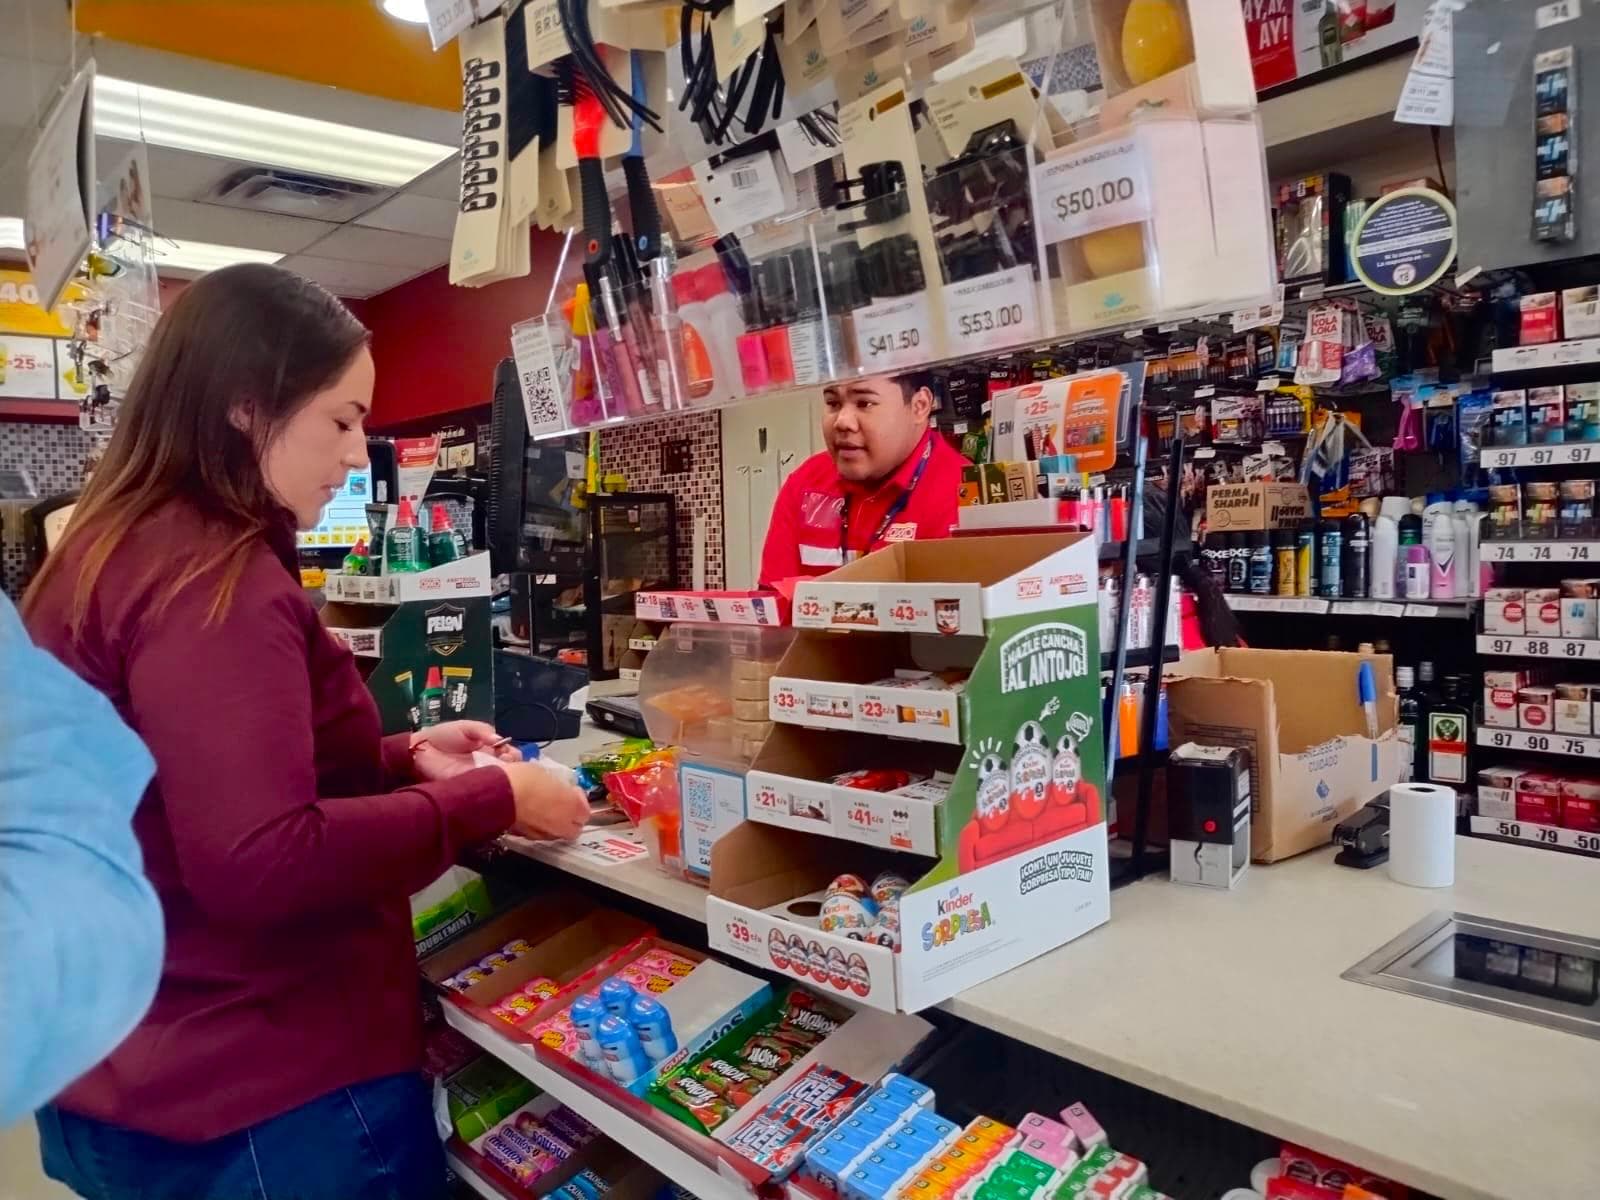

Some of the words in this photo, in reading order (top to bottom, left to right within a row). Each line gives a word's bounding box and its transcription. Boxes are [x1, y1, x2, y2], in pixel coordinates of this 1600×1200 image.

[1259, 15, 1288, 51] AY!
[1056, 177, 1134, 222] $50.00
[959, 303, 1023, 337] $53.00
[1312, 315, 1338, 326] KOLA
[868, 328, 920, 356] $41.50
[1497, 452, 1517, 466] 97
[1533, 450, 1553, 464] 97
[1570, 448, 1591, 462] 97
[1211, 488, 1249, 499] PERMA
[1213, 498, 1249, 509] SHARP
[1497, 547, 1515, 560] 74
[1533, 547, 1551, 560] 74
[1570, 546, 1589, 560] 74
[798, 602, 821, 617] $32
[889, 605, 916, 621] $43
[1007, 636, 1041, 669] HAZLE
[1041, 633, 1081, 655] CANCHA
[1494, 639, 1513, 653] 97
[1528, 641, 1549, 655] 88
[1566, 642, 1586, 657] 87
[1007, 661, 1028, 693] AL
[1028, 649, 1082, 688] ANTOJO
[773, 693, 796, 709] $33
[858, 701, 884, 718] $23
[1494, 732, 1513, 747] 97
[1528, 736, 1550, 750] 90
[1565, 739, 1586, 754] 75
[755, 792, 777, 808] $21
[847, 808, 872, 827] $41
[1500, 822, 1521, 837] 50
[1540, 829, 1558, 844] 79
[1578, 835, 1600, 851] 50
[1046, 852, 1060, 868] UN
[1060, 850, 1093, 868] JUGUETE
[1020, 867, 1059, 895] SORPRESA
[1060, 867, 1077, 880] TIPO
[937, 892, 974, 917] Kinder
[726, 921, 750, 944] $39
[921, 900, 992, 952] SORPRESA
[662, 1048, 689, 1073] GUM
[488, 1134, 523, 1165] mentos
[502, 1127, 535, 1155] mentos
